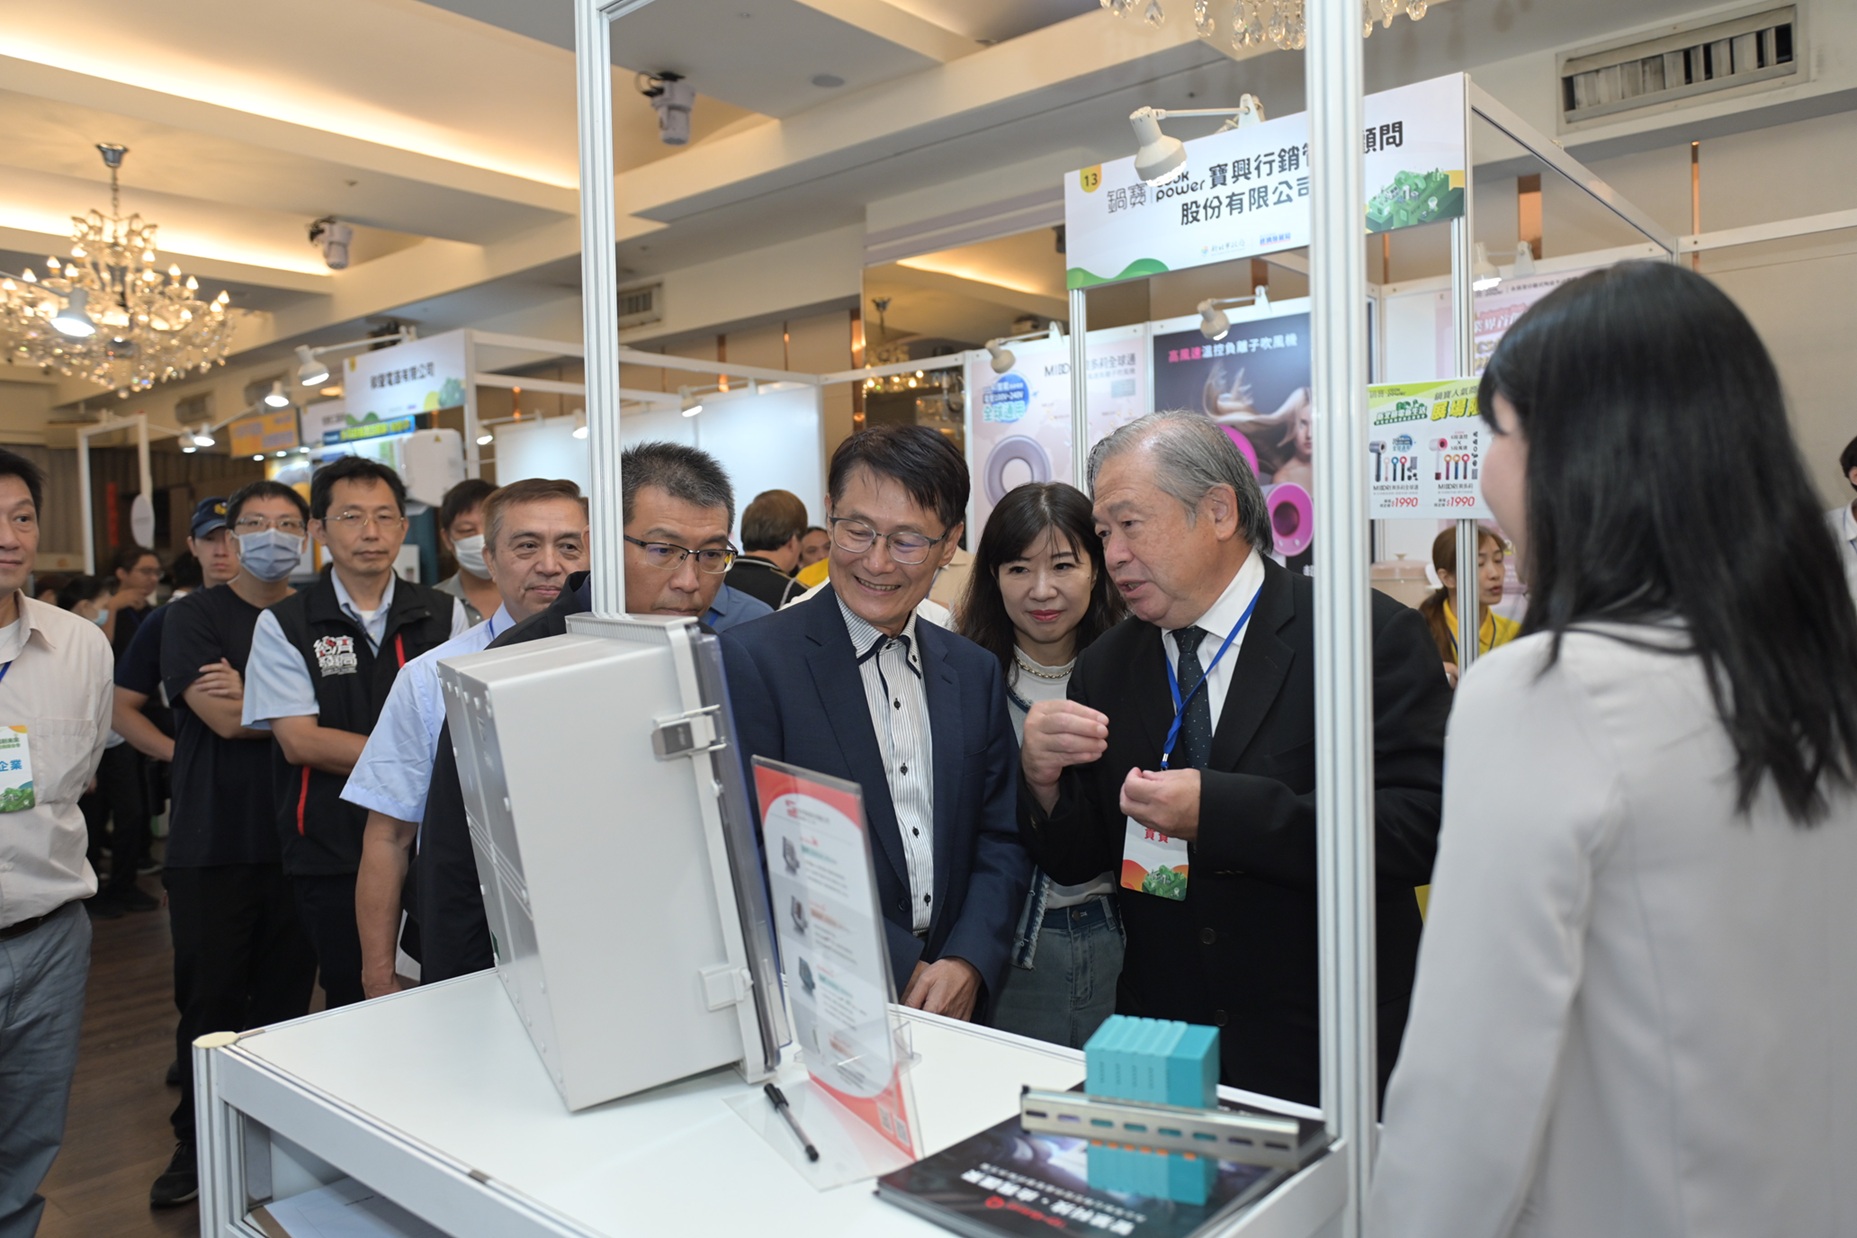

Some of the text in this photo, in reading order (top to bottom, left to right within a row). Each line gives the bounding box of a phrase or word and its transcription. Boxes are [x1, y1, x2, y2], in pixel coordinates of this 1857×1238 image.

[1084, 172, 1098, 187] 13
[1156, 180, 1205, 202] power
[1106, 182, 1148, 214] 鍋寶
[1180, 175, 1310, 226] 股份有限公司
[313, 635, 354, 658] 經濟
